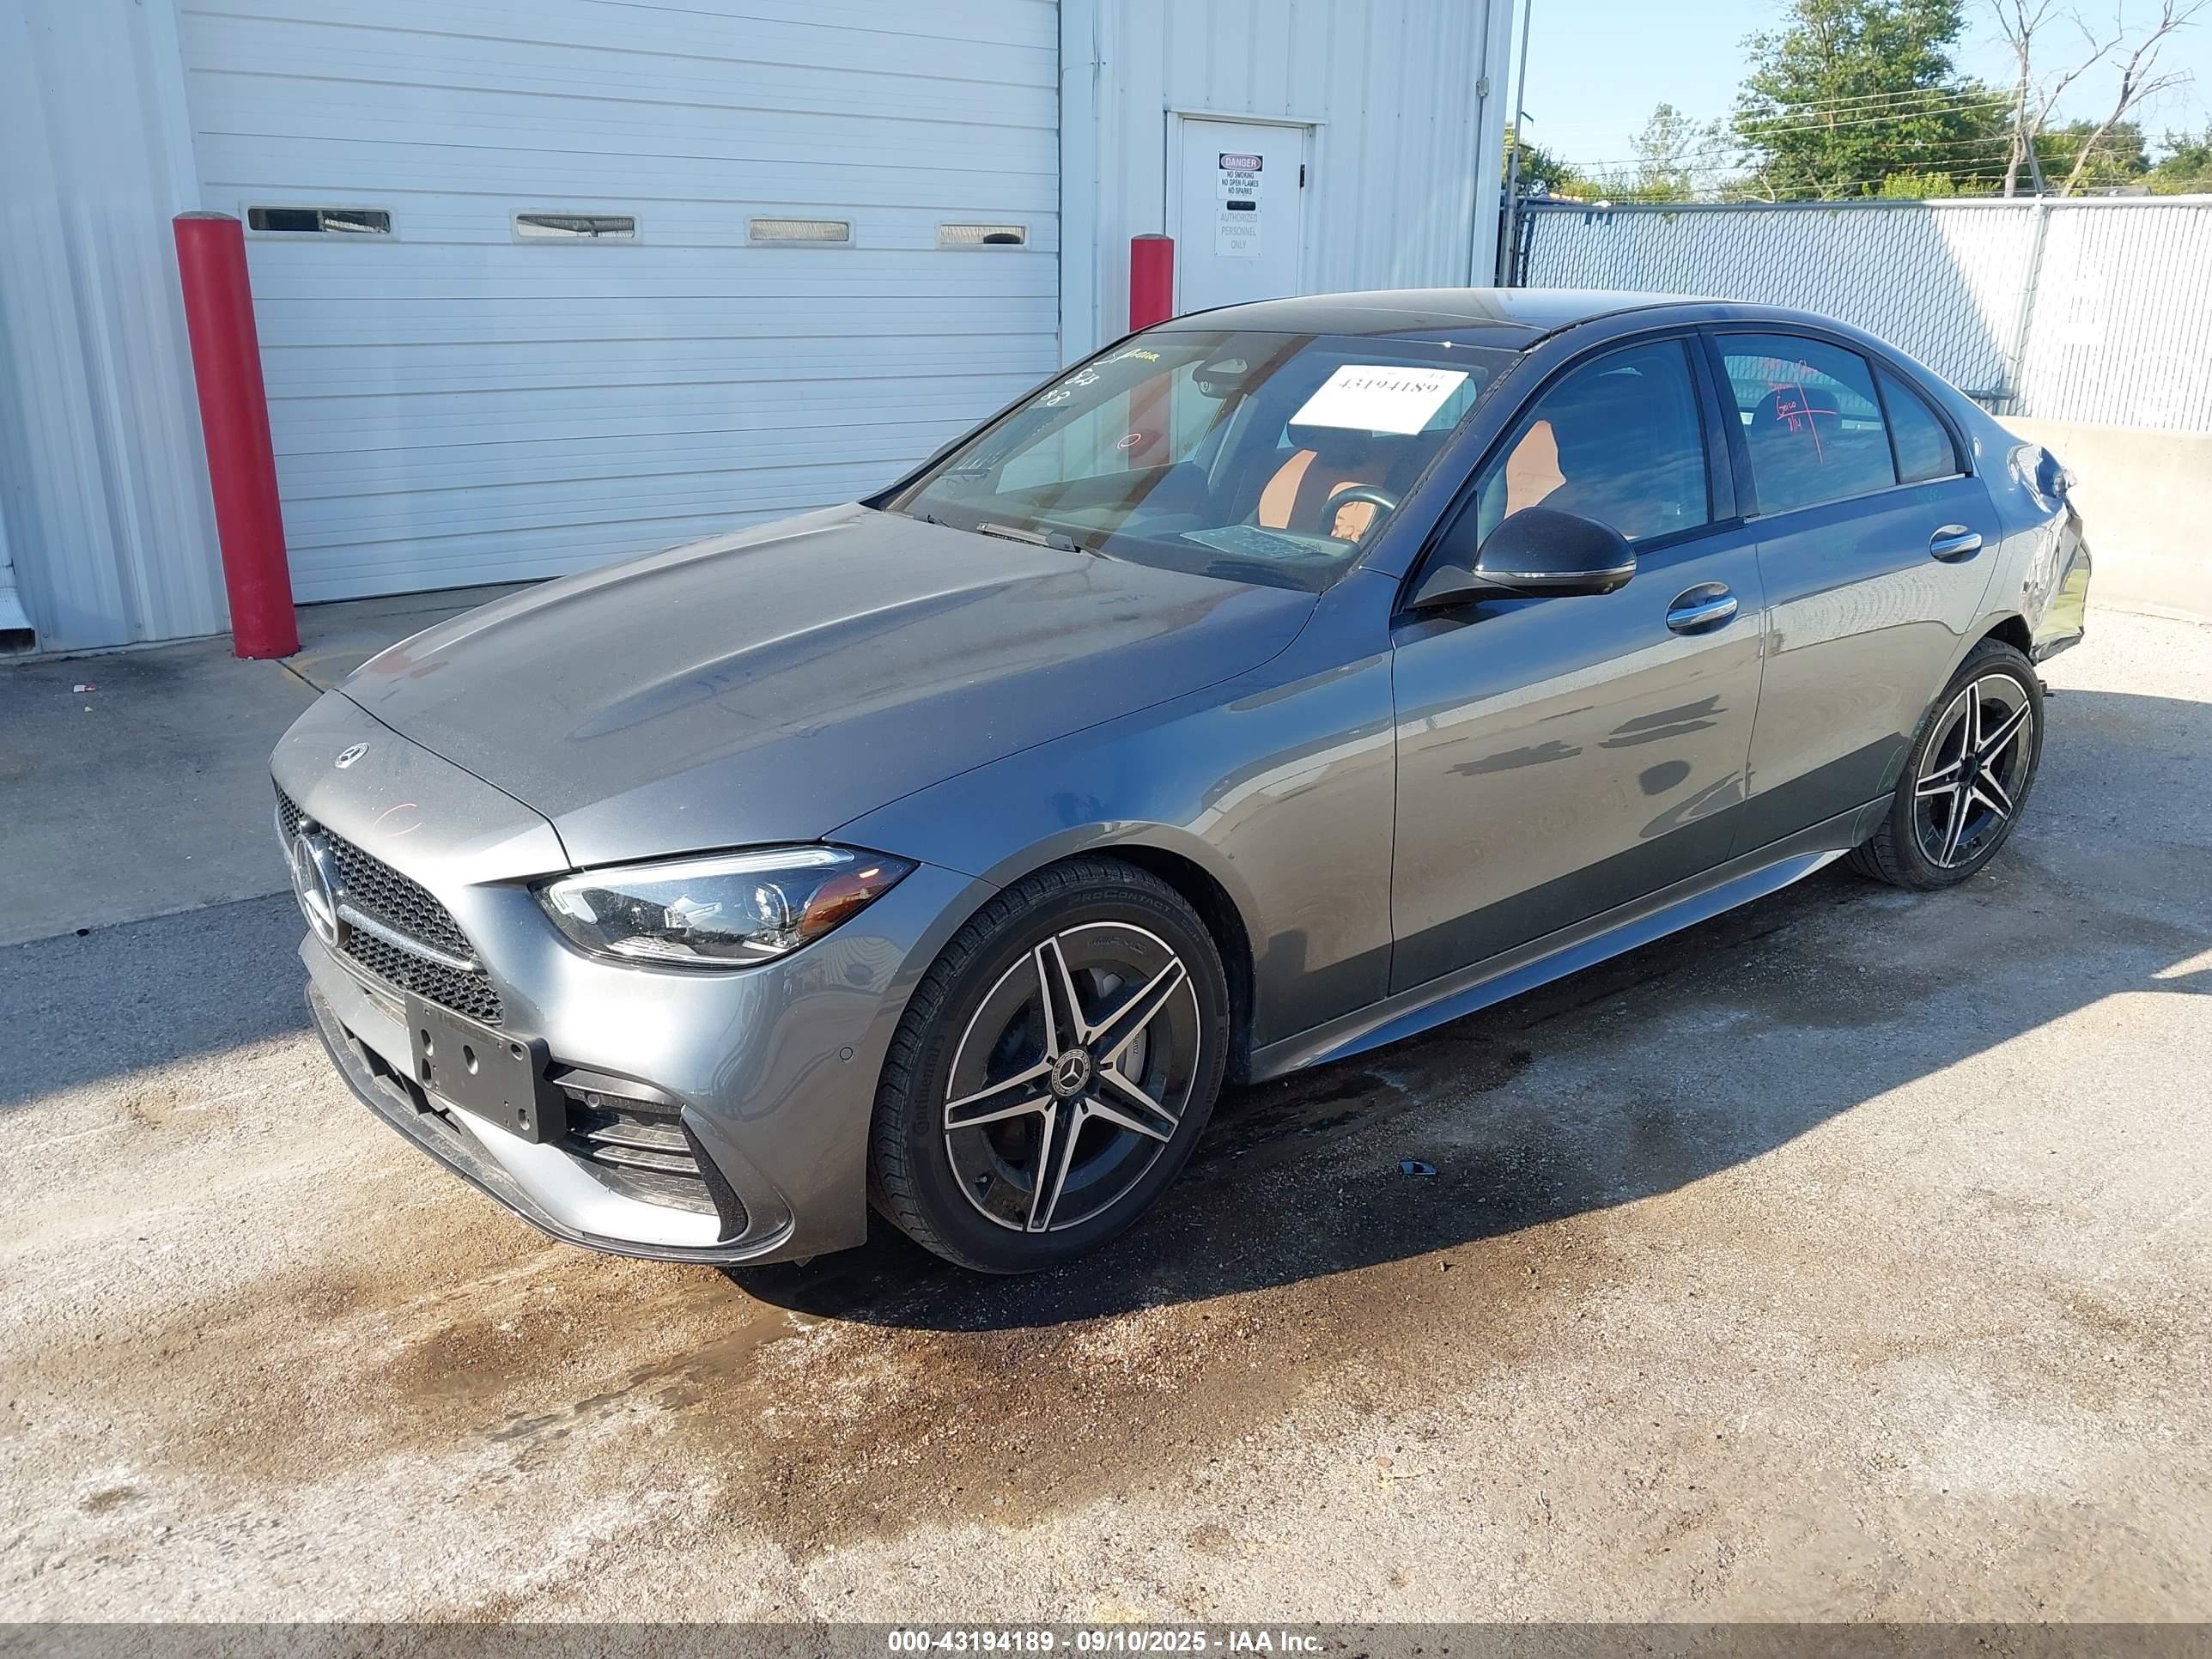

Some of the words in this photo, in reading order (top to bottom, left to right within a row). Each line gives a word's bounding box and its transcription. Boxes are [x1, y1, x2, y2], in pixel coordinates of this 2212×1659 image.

[1225, 157, 1256, 167] DANGER
[1221, 213, 1257, 222] AUTHORIZED
[1221, 226, 1256, 236] PERSONNEL
[1231, 240, 1247, 249] ONLY
